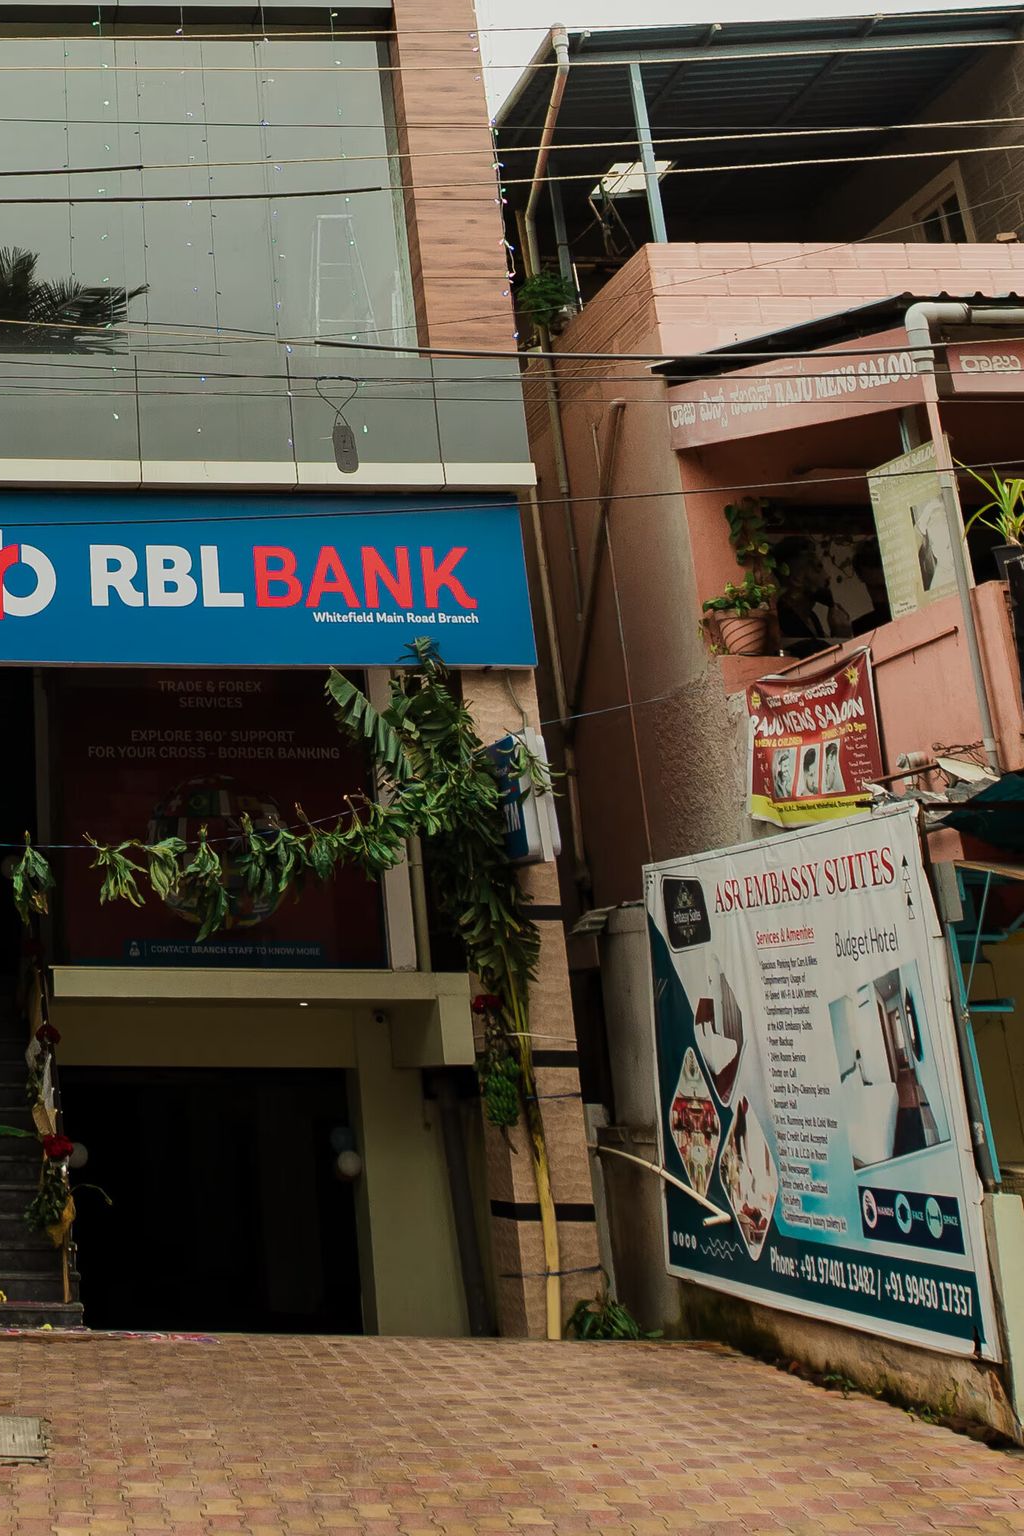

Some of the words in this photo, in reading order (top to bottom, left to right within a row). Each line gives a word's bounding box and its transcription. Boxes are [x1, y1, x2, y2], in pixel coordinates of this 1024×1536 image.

[959, 355, 1022, 375] ರಾಜು
[775, 377, 813, 407] RAJU
[815, 365, 857, 399] MENS
[89, 544, 245, 608] RBL
[252, 545, 478, 609] BANK
[313, 612, 374, 623] Whitefield
[376, 613, 404, 623] Main
[406, 613, 436, 624] Road
[438, 613, 479, 624] Branch
[157, 680, 203, 693] TRADE
[205, 681, 216, 693] &
[218, 681, 262, 693] FOREX
[178, 696, 244, 709] SERVICES
[782, 707, 817, 733] MENS
[815, 696, 866, 730] SALOON
[131, 730, 192, 742] EXPLORE
[230, 730, 296, 743] SUPPORT
[88, 747, 116, 758] FOR
[118, 747, 157, 759] YOUR
[159, 747, 207, 759] CROSS
[217, 747, 275, 760] BORDER
[278, 747, 341, 760] BANKING
[715, 879, 744, 914] ASR
[744, 863, 820, 908] EMBASSY
[824, 847, 895, 895] SUITES
[756, 927, 779, 945] Services
[786, 924, 815, 941] Amenities
[834, 931, 868, 962] Budget
[869, 924, 899, 954] Hotel
[150, 944, 189, 954] CONTACT
[191, 945, 227, 955] BRANCH
[228, 945, 253, 955] STAFF
[254, 945, 266, 955] TO
[267, 946, 295, 956] KNOW
[296, 946, 321, 956] MORE
[943, 1215, 958, 1226] SPACE
[800, 1254, 817, 1282] +91
[818, 1255, 846, 1289] 97401
[847, 1263, 876, 1295] 13482
[885, 1271, 905, 1302] +91
[905, 1274, 939, 1310] 99450
[939, 1282, 973, 1317] 17337
